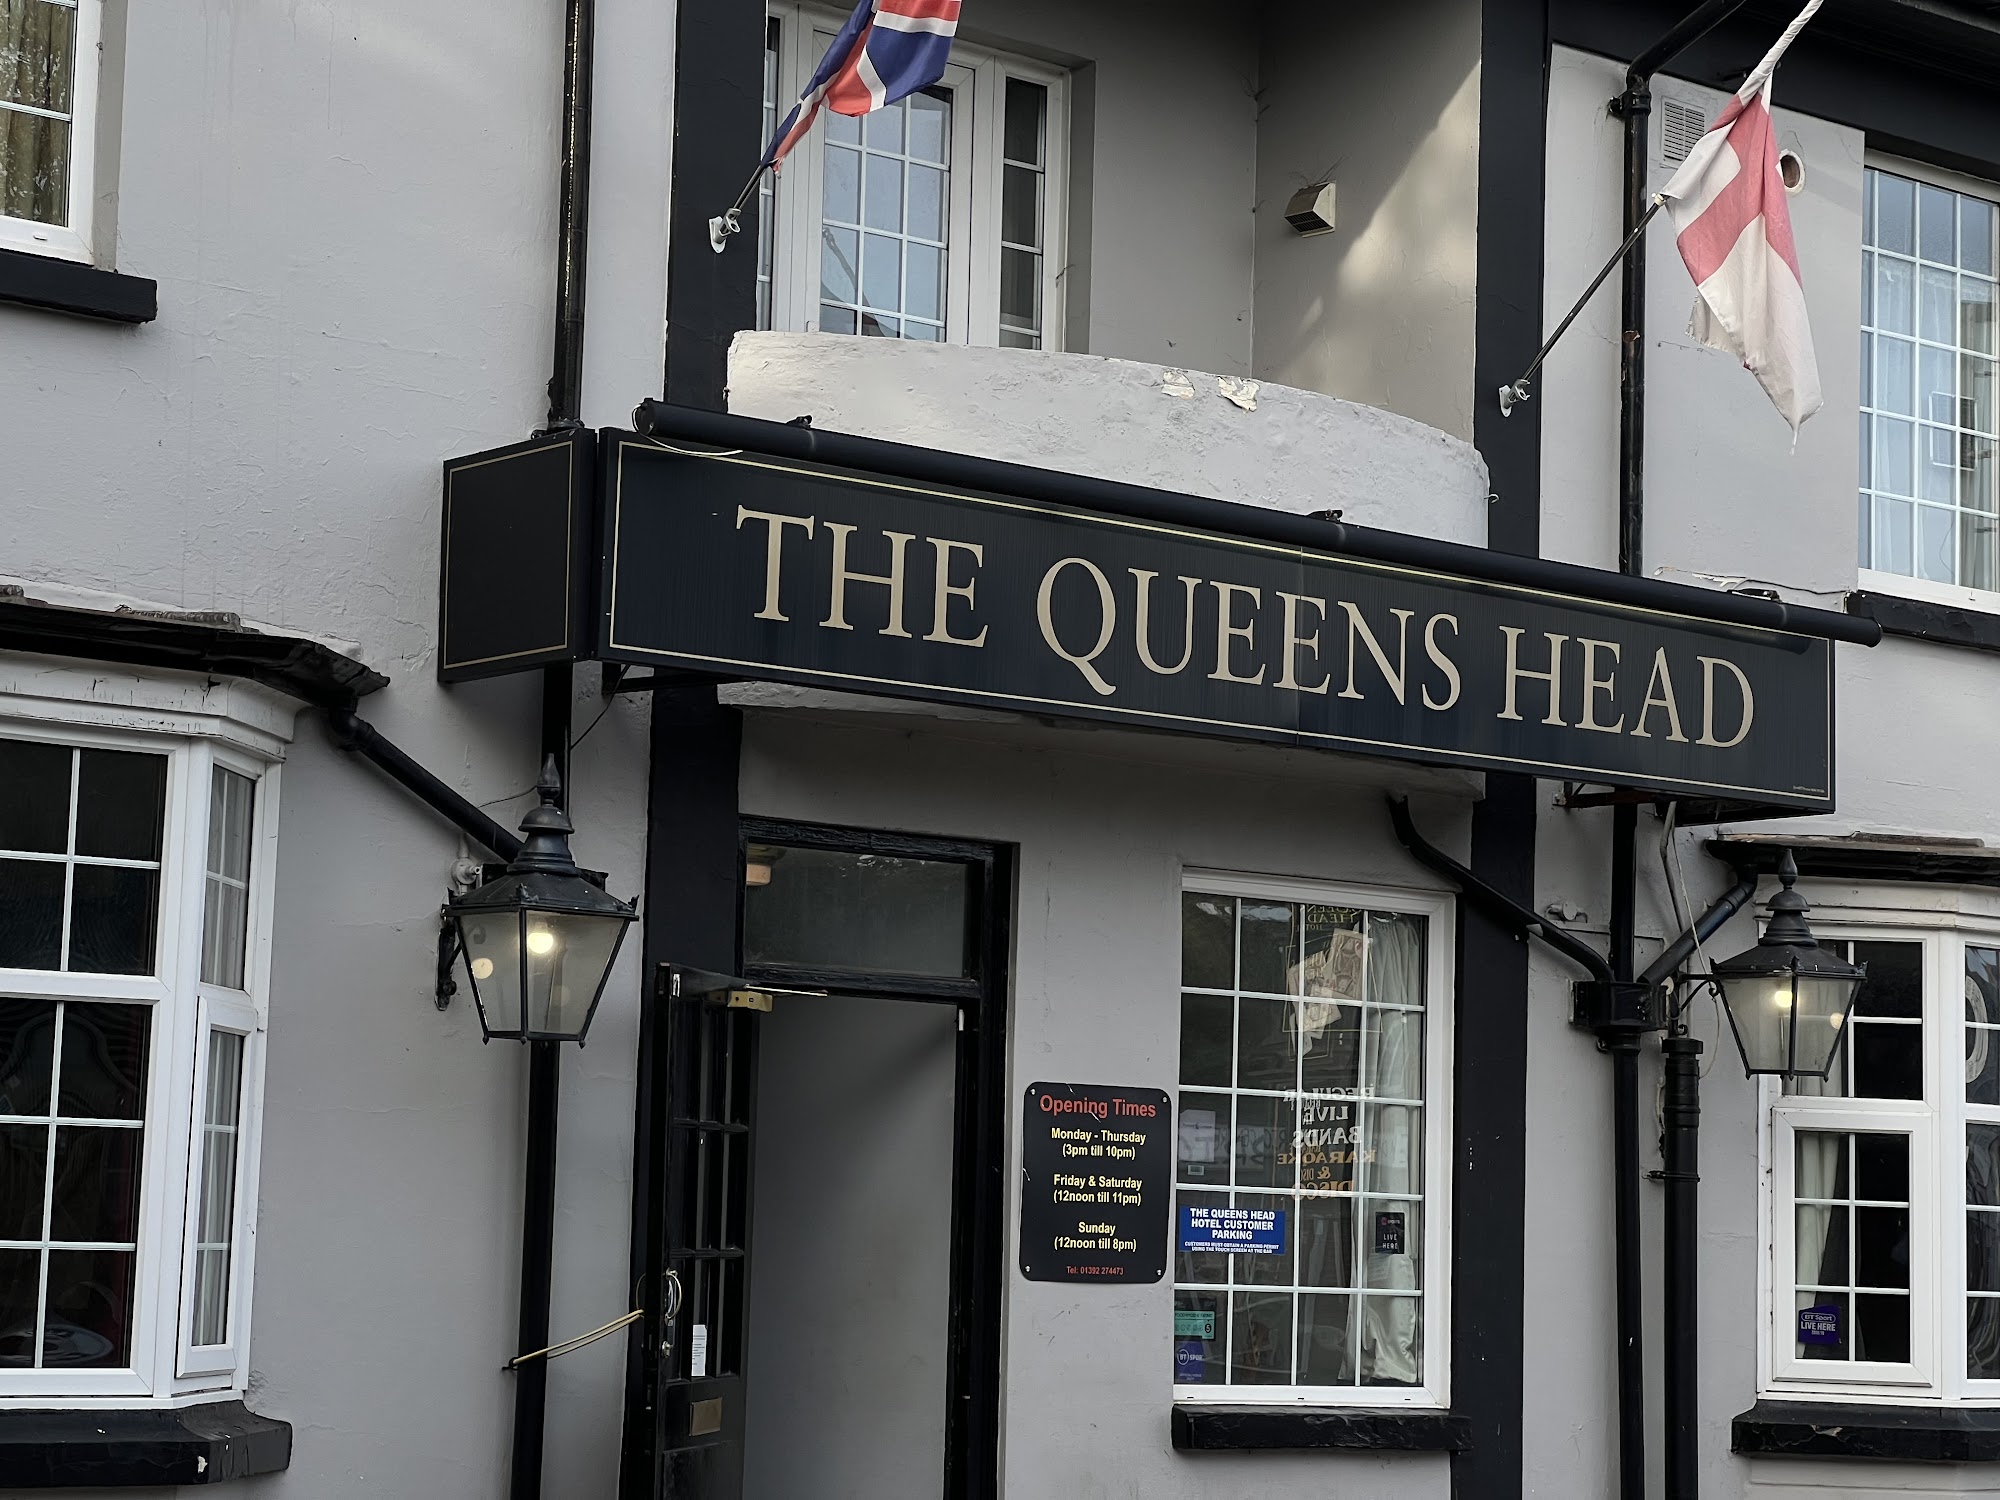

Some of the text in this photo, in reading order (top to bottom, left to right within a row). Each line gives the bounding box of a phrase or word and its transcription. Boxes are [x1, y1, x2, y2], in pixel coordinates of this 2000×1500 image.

[735, 503, 1756, 749] THE QUEENS HEAD
[1039, 1094, 1157, 1119] Opening Times
[1051, 1127, 1092, 1143] Monday
[1100, 1129, 1147, 1146] Thursday
[1062, 1143, 1136, 1160] (3pm till 10pm)
[1053, 1173, 1143, 1192] Friday & Saturday
[1053, 1189, 1142, 1206] (12noon till 11pm)
[1189, 1207, 1276, 1220] THE QUEENS HEAD
[1078, 1221, 1116, 1236] Sunday
[1191, 1218, 1274, 1231] HOTEL CUSTOMER
[1211, 1229, 1253, 1240] PARKING
[1383, 1233, 1398, 1241] LIVE
[1054, 1236, 1137, 1252] (12noon till 8pm)
[1382, 1242, 1398, 1250] HERE
[1066, 1265, 1124, 1275] Tel: 01392 274473
[1800, 1321, 1836, 1331] LIVE HERE
